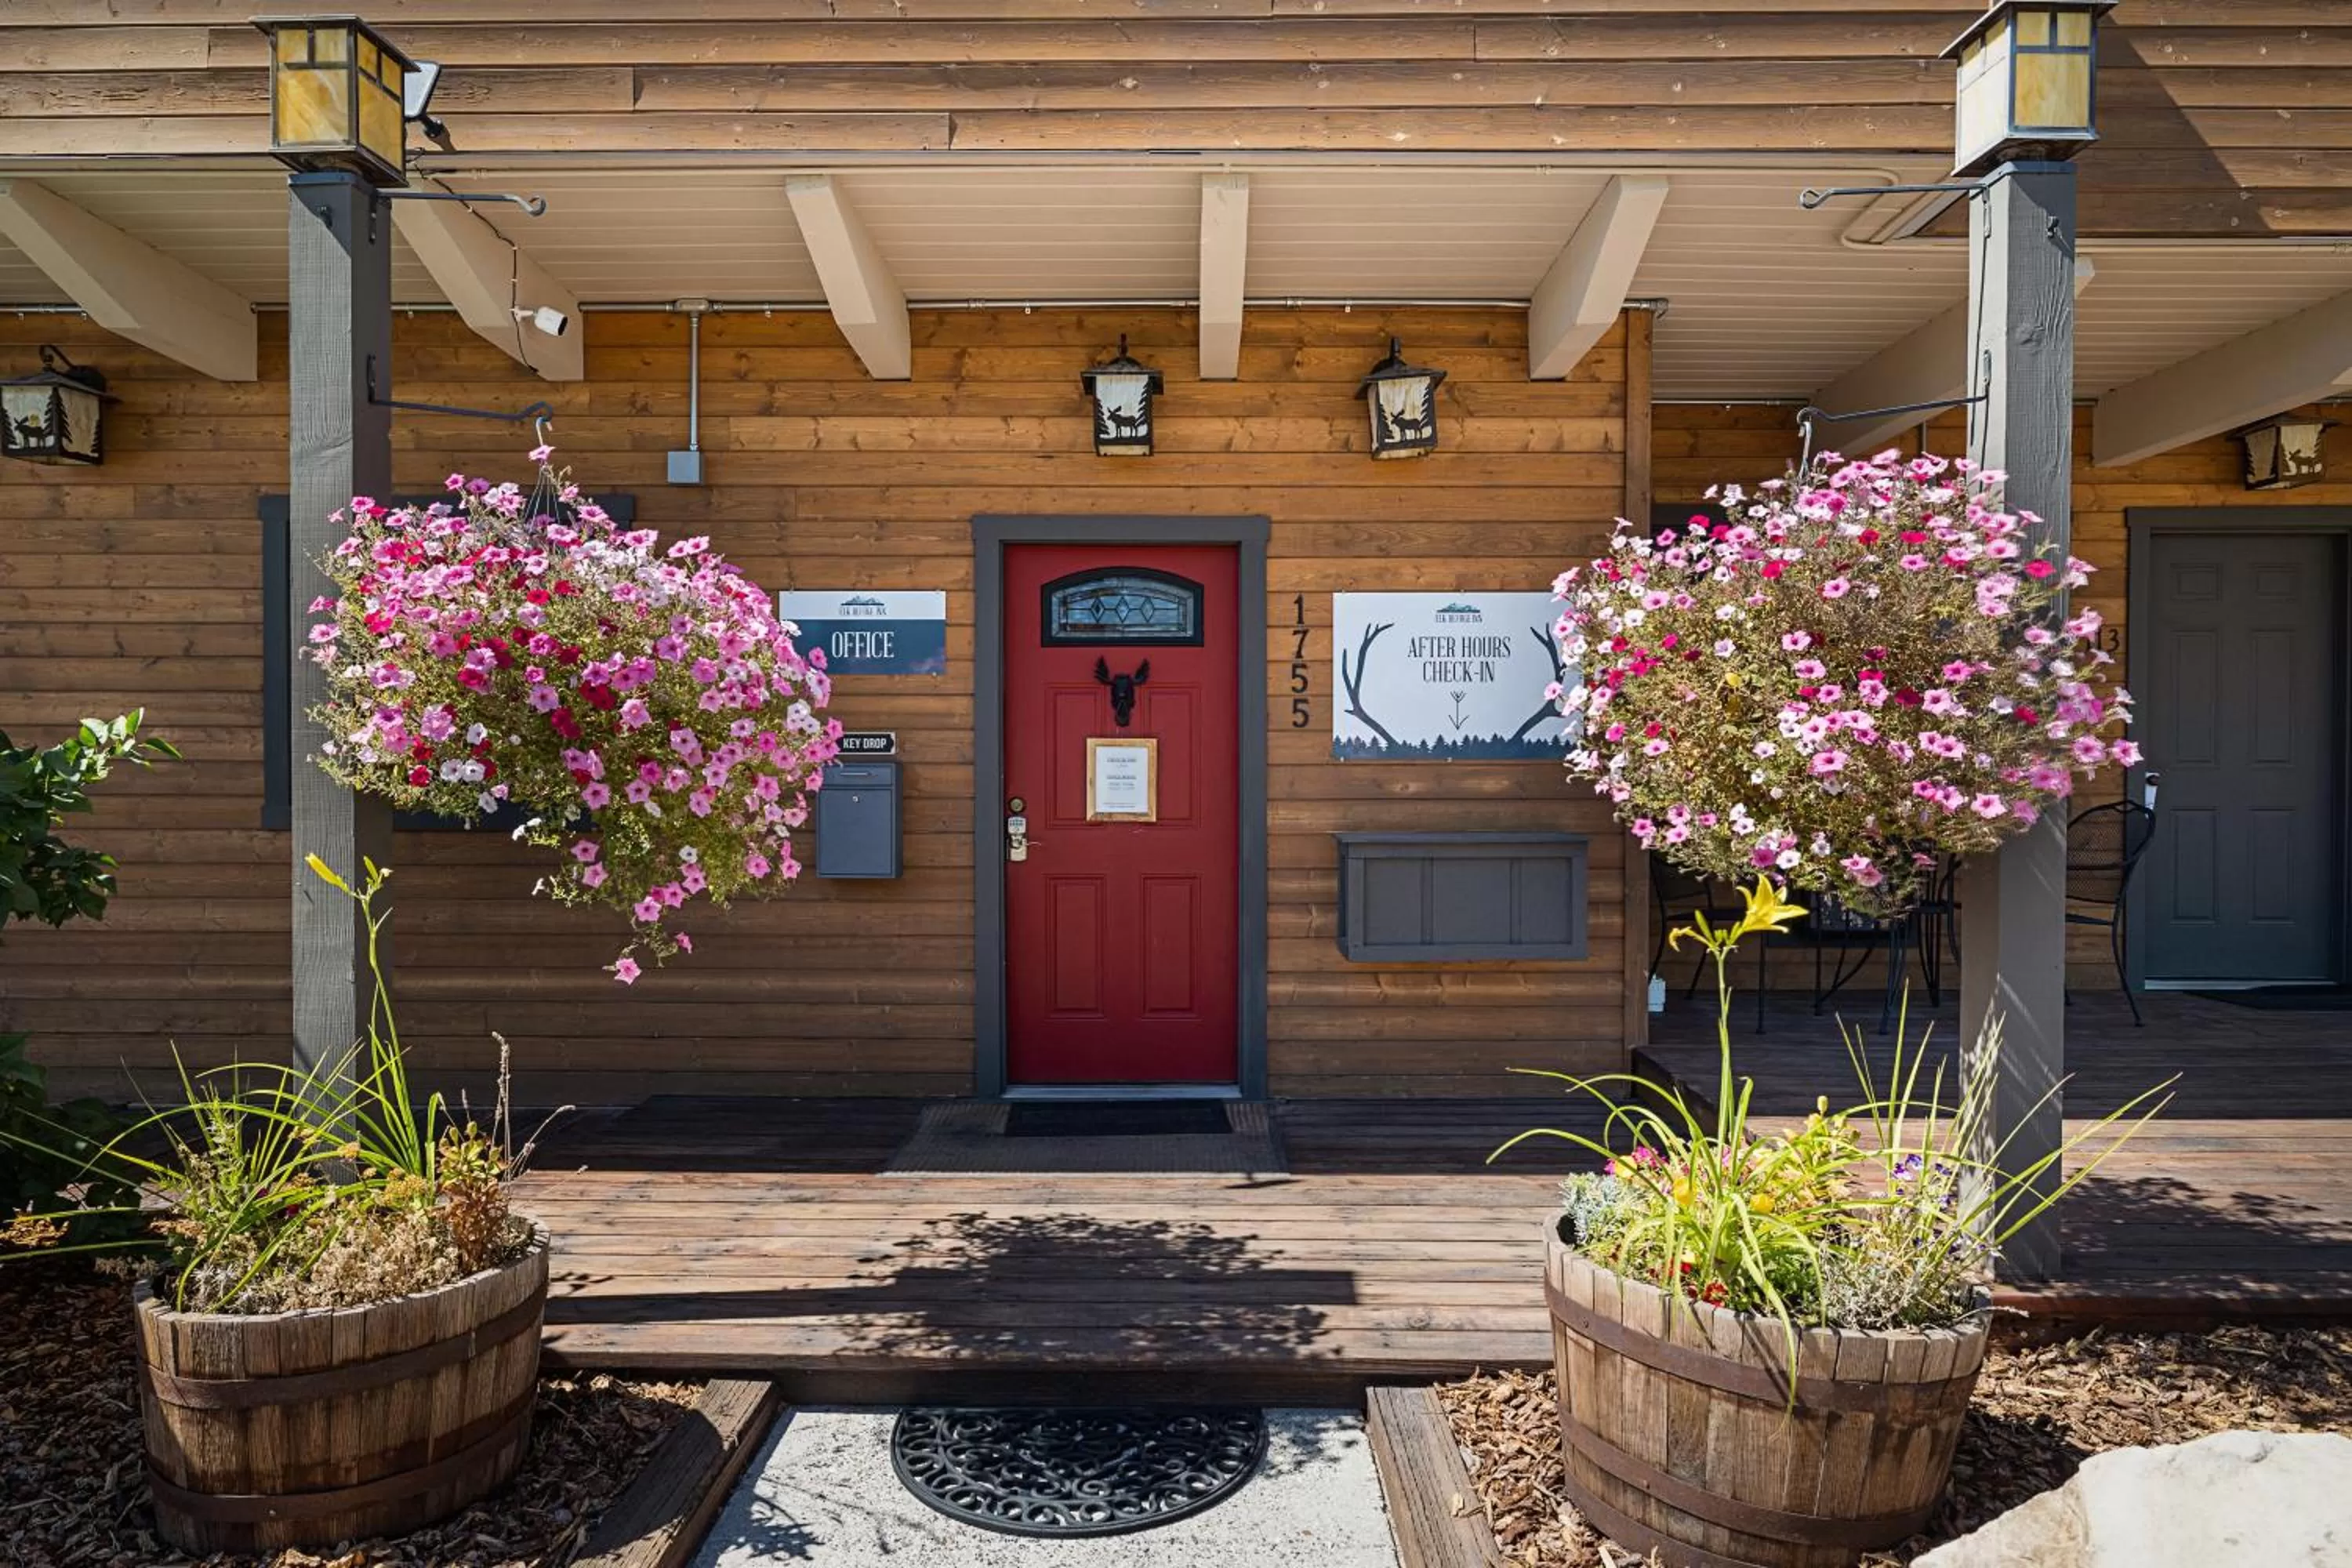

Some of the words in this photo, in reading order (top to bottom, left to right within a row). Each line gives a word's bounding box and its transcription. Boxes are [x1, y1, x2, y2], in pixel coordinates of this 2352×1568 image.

[832, 631, 895, 658] OFFICE
[1407, 636, 1456, 658] AFTER
[1461, 636, 1511, 658] HOURS
[1292, 593, 1310, 728] 1755
[1423, 661, 1494, 682] CHECK-IN
[843, 738, 861, 749] KEY
[863, 738, 887, 749] DROP
